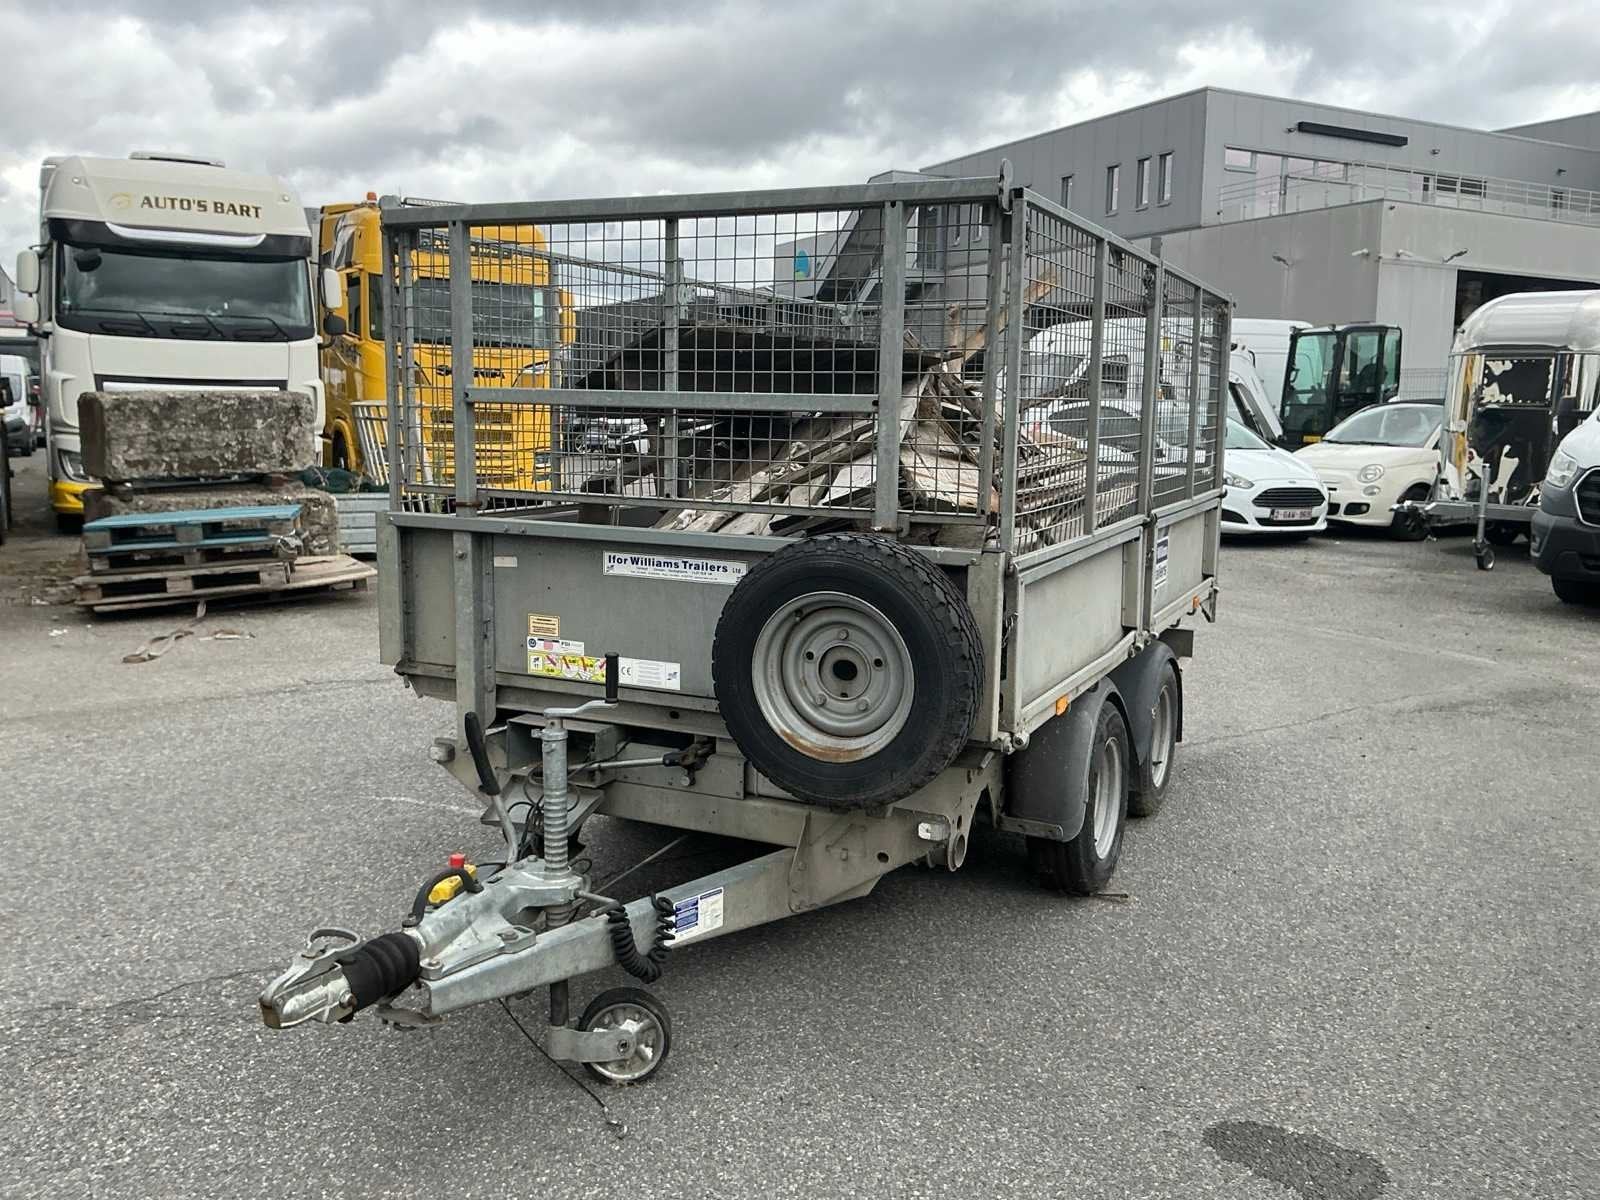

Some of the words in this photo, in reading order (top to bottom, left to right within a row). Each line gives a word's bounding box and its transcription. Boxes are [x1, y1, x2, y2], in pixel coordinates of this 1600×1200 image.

[141, 195, 208, 213] AUTO'S
[213, 201, 262, 219] BART
[608, 555, 629, 565] Ifor
[630, 556, 680, 569] Williams
[682, 560, 728, 573] Trailers
[621, 666, 632, 676] CE
